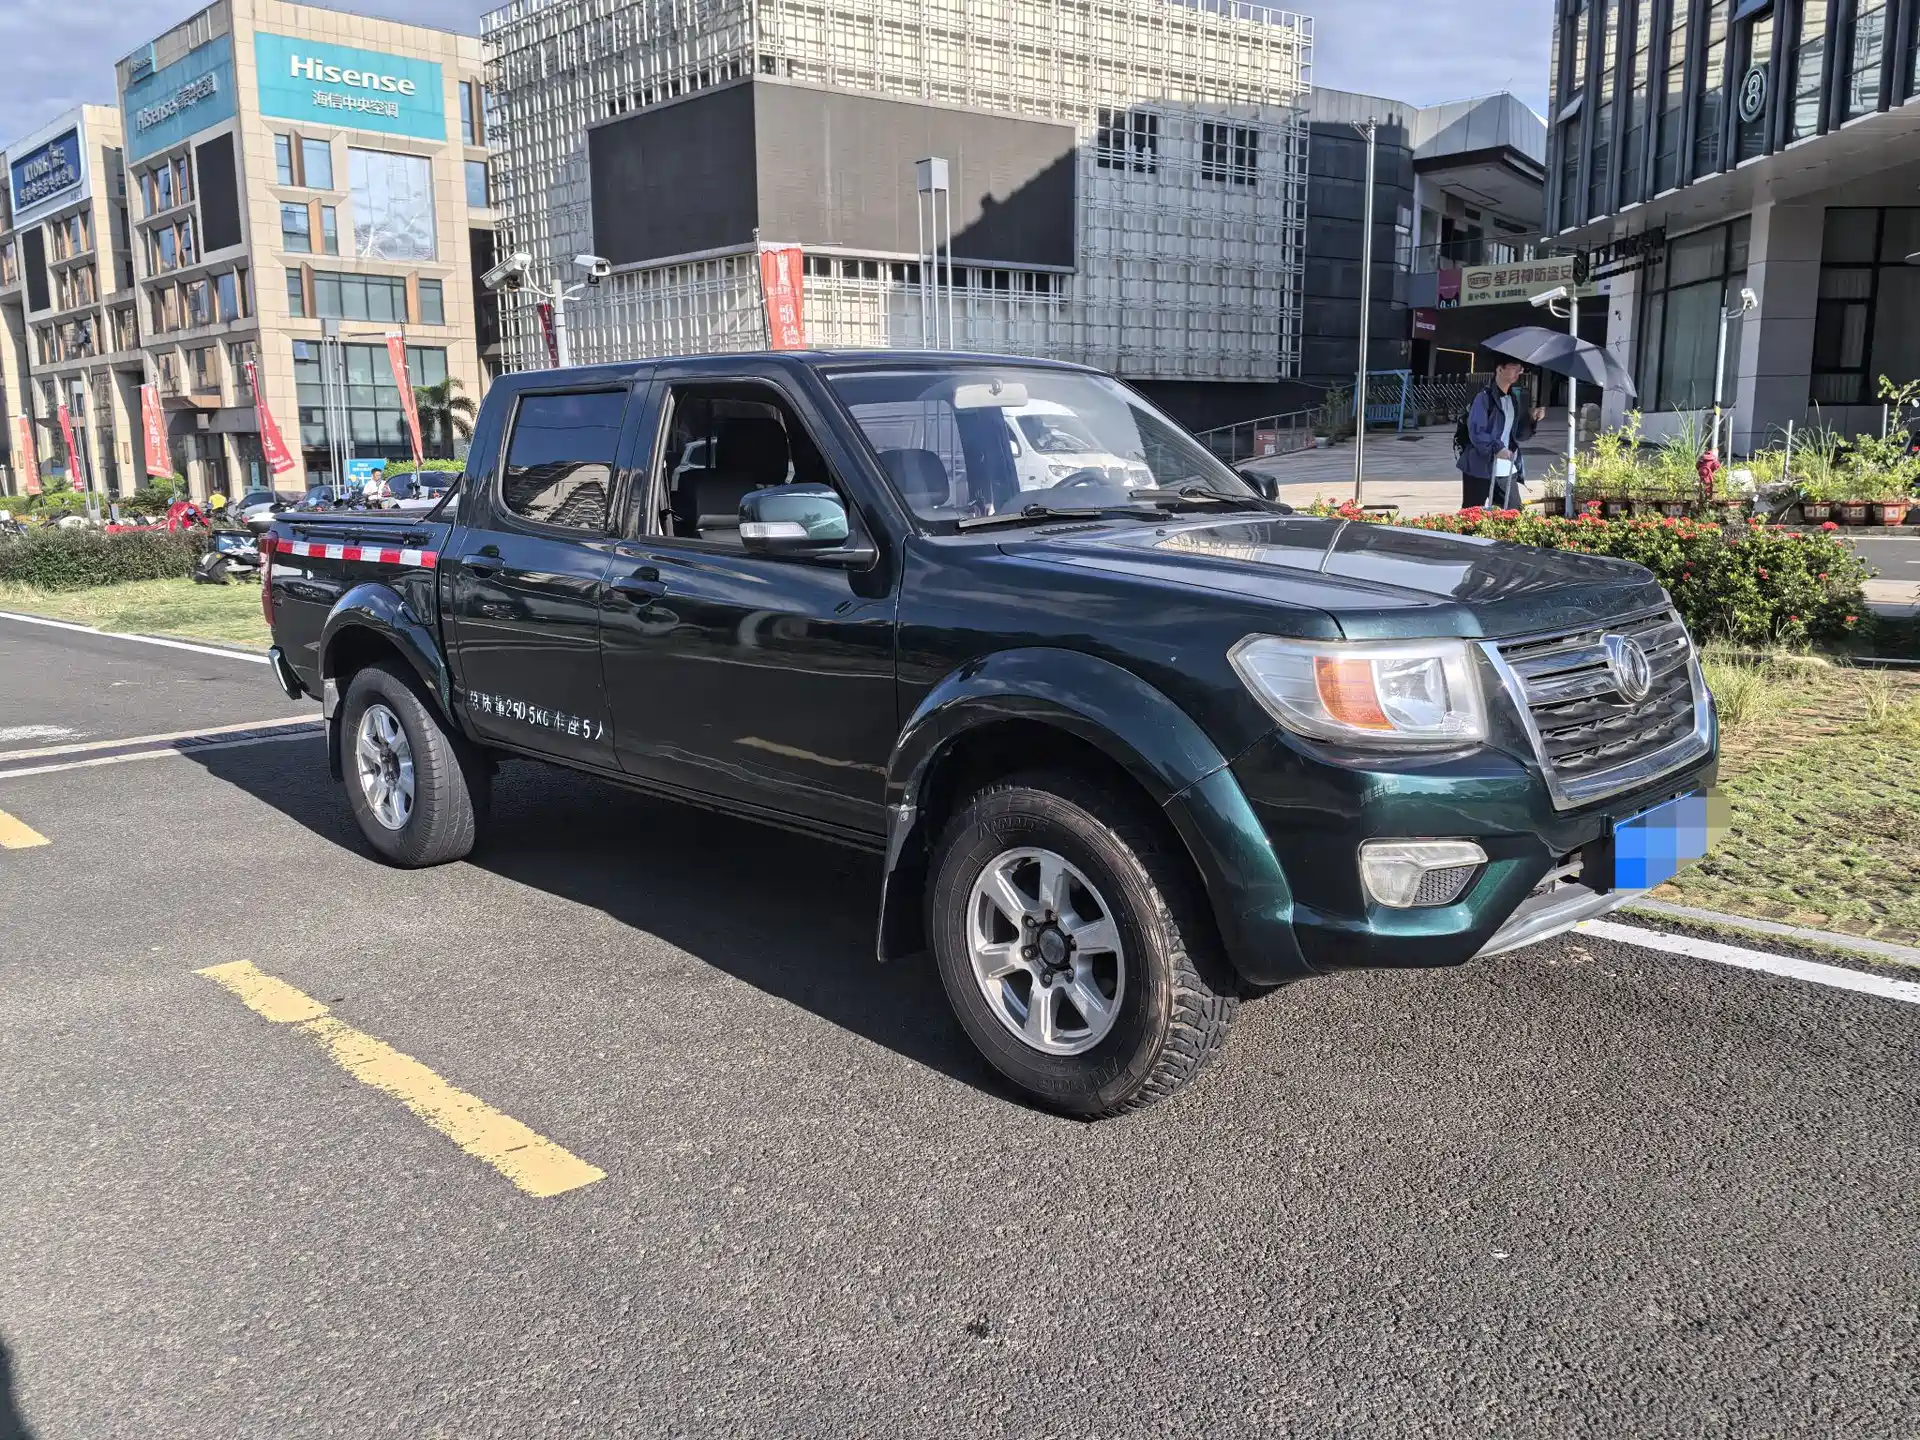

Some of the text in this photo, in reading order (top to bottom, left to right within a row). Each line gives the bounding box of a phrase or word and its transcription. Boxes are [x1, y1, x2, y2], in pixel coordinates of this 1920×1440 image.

[290, 54, 416, 95] Hisense
[1745, 74, 1761, 112] 8
[312, 90, 399, 118] 海信中央空调
